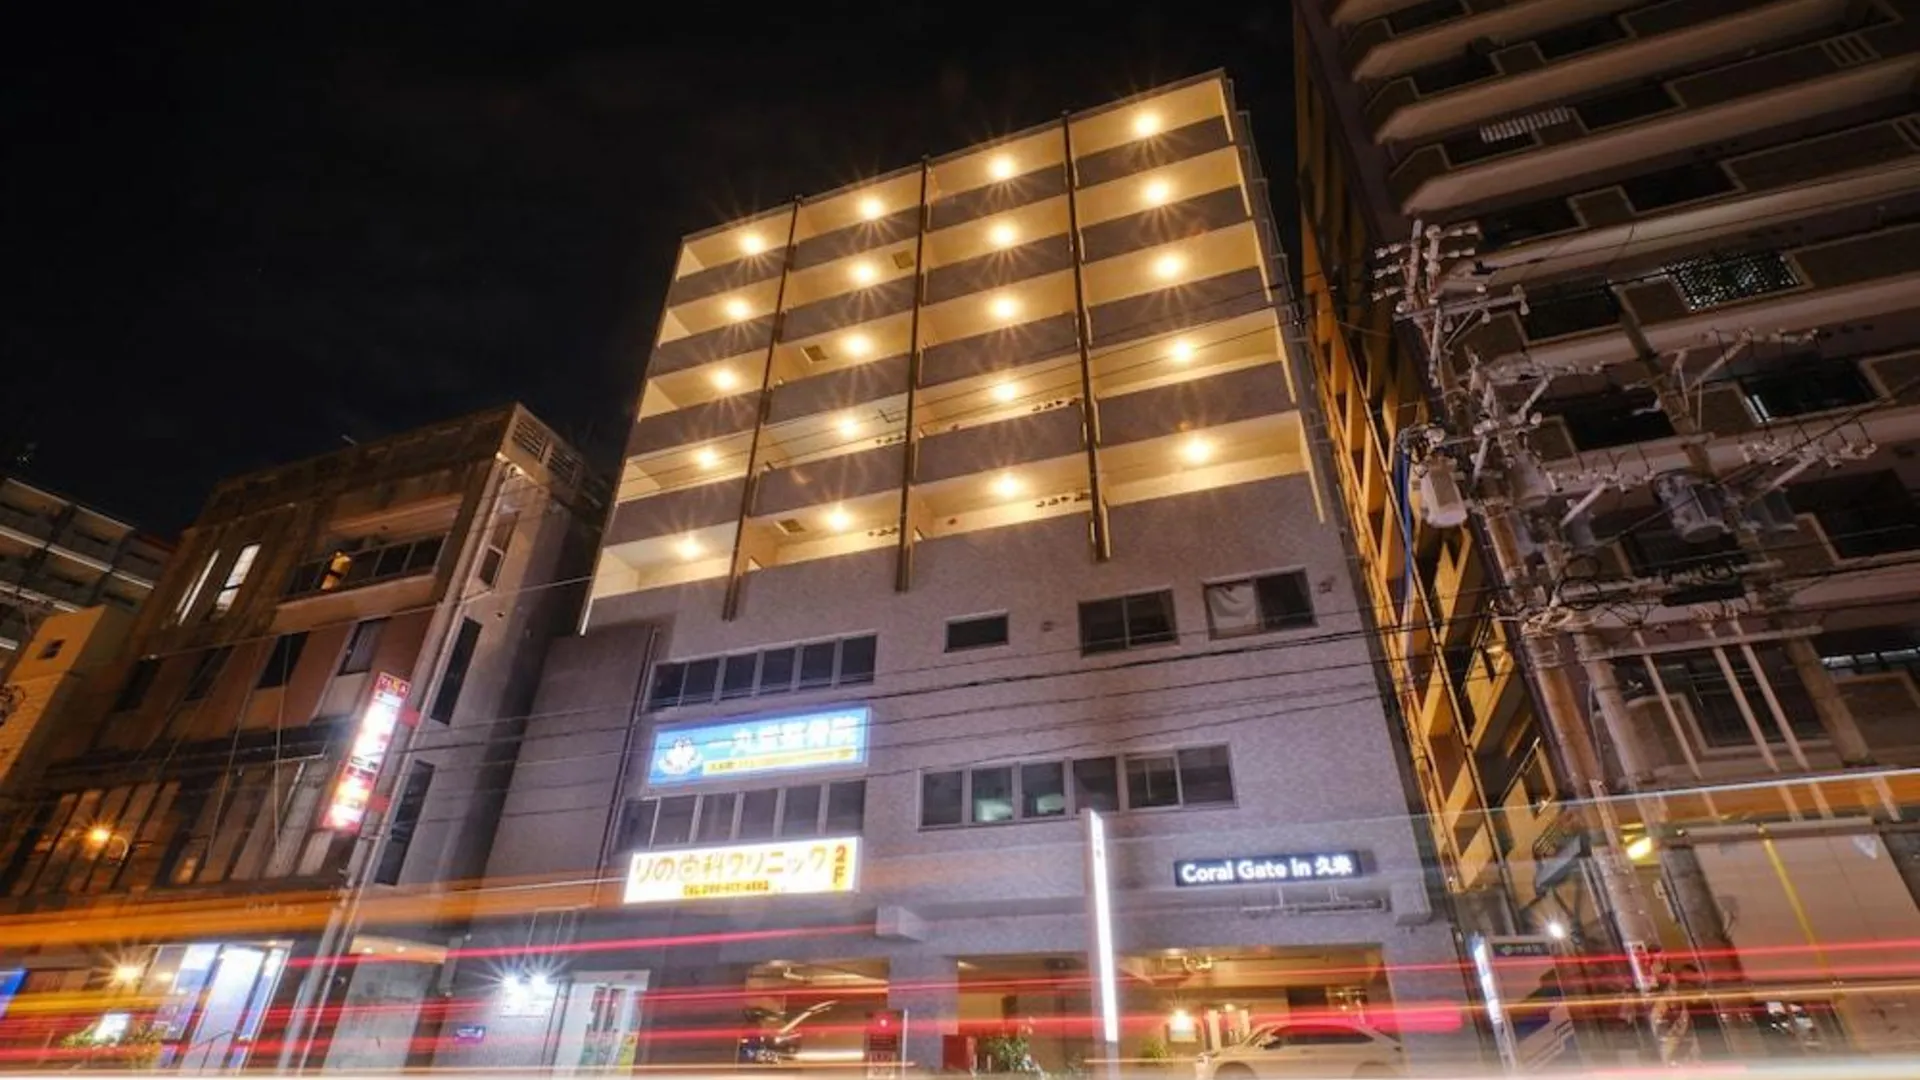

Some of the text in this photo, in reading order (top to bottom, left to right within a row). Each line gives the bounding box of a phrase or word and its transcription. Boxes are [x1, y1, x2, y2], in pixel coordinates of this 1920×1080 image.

[636, 845, 827, 884] りの歯科クリニック
[1182, 861, 1233, 882] Coral
[1238, 860, 1287, 879] Gate
[1315, 855, 1352, 875] 久米
